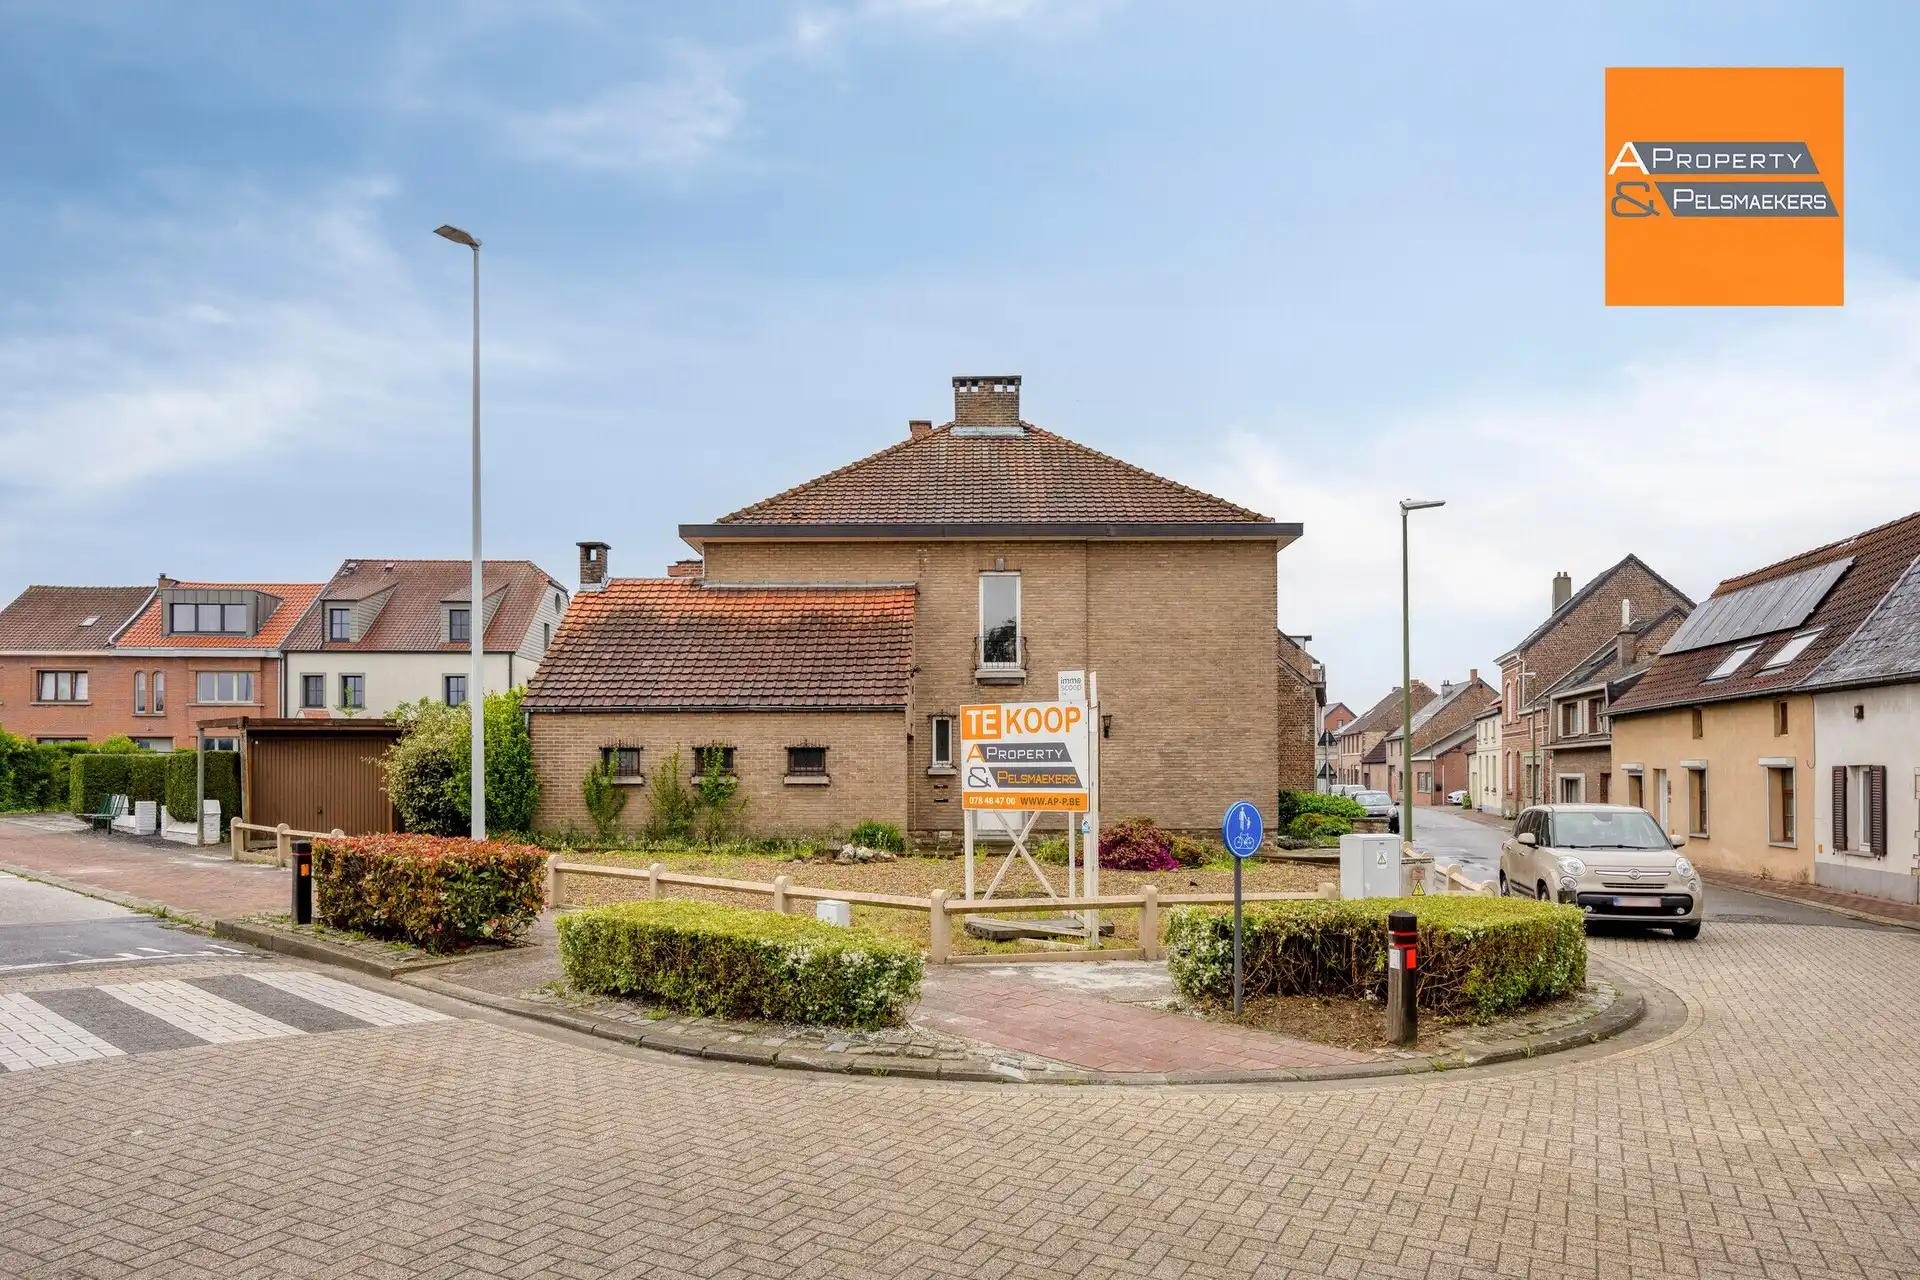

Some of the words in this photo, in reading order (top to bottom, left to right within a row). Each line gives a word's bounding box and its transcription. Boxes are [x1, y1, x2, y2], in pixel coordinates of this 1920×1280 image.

[1060, 676, 1082, 685] immo
[966, 709, 997, 735] TE
[1006, 707, 1081, 734] KOOP
[966, 744, 985, 763] A
[986, 746, 1063, 760] PROPERTY
[968, 767, 991, 788] &
[997, 770, 1077, 785] PELSMAEKERS
[969, 796, 983, 805] 078
[984, 796, 994, 805] 48
[995, 796, 1004, 805] 47
[1006, 796, 1016, 805] 00
[1020, 797, 1081, 806] WWW.AP-P.BE
